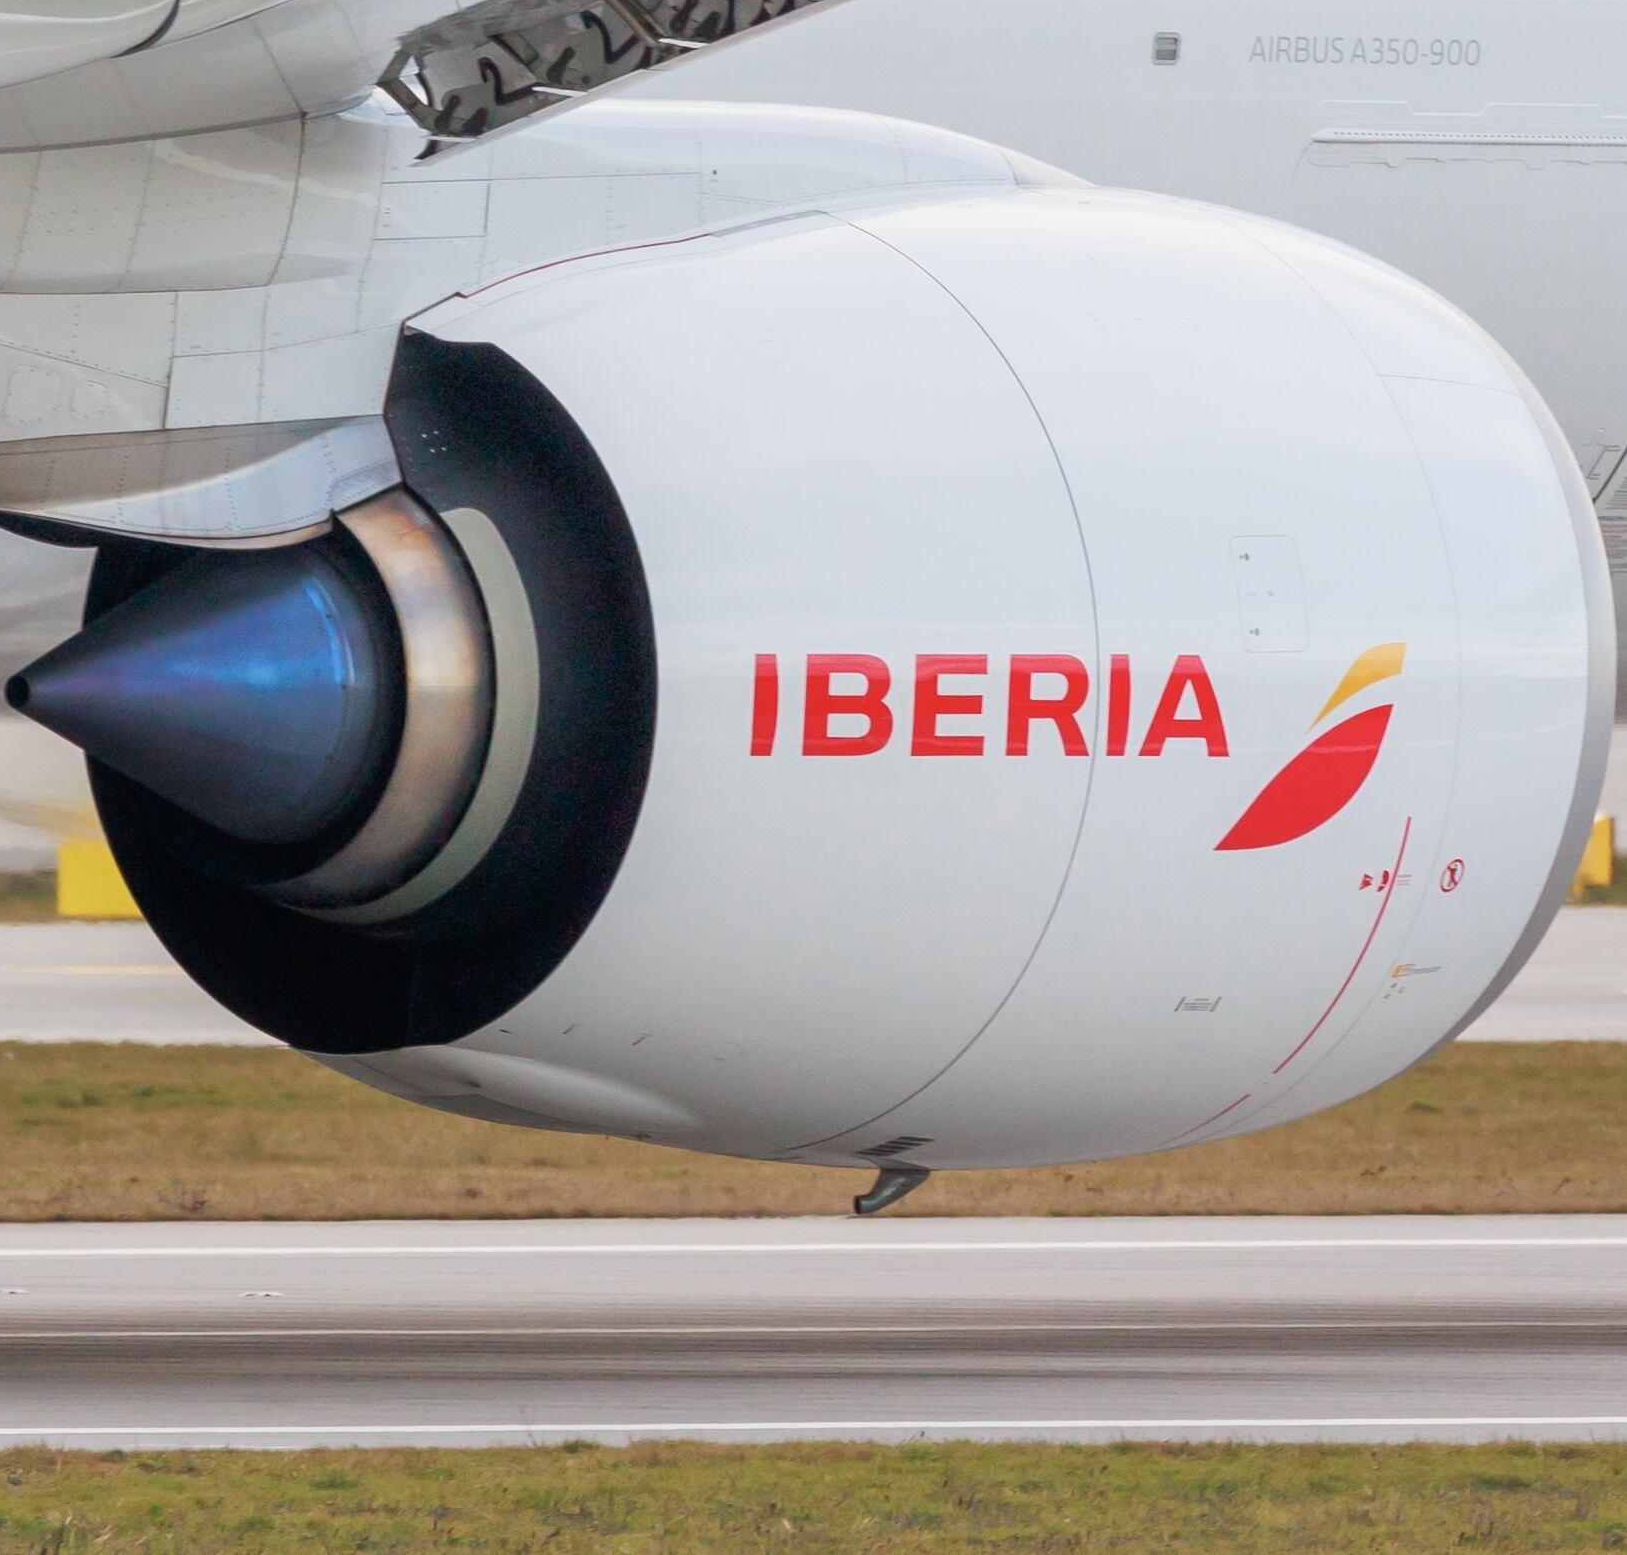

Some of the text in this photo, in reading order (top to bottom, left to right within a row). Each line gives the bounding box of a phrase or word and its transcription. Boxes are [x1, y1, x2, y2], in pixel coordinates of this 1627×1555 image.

[1249, 35, 1481, 67] AIRBUS A350-900
[749, 653, 1230, 758] IBERIA
